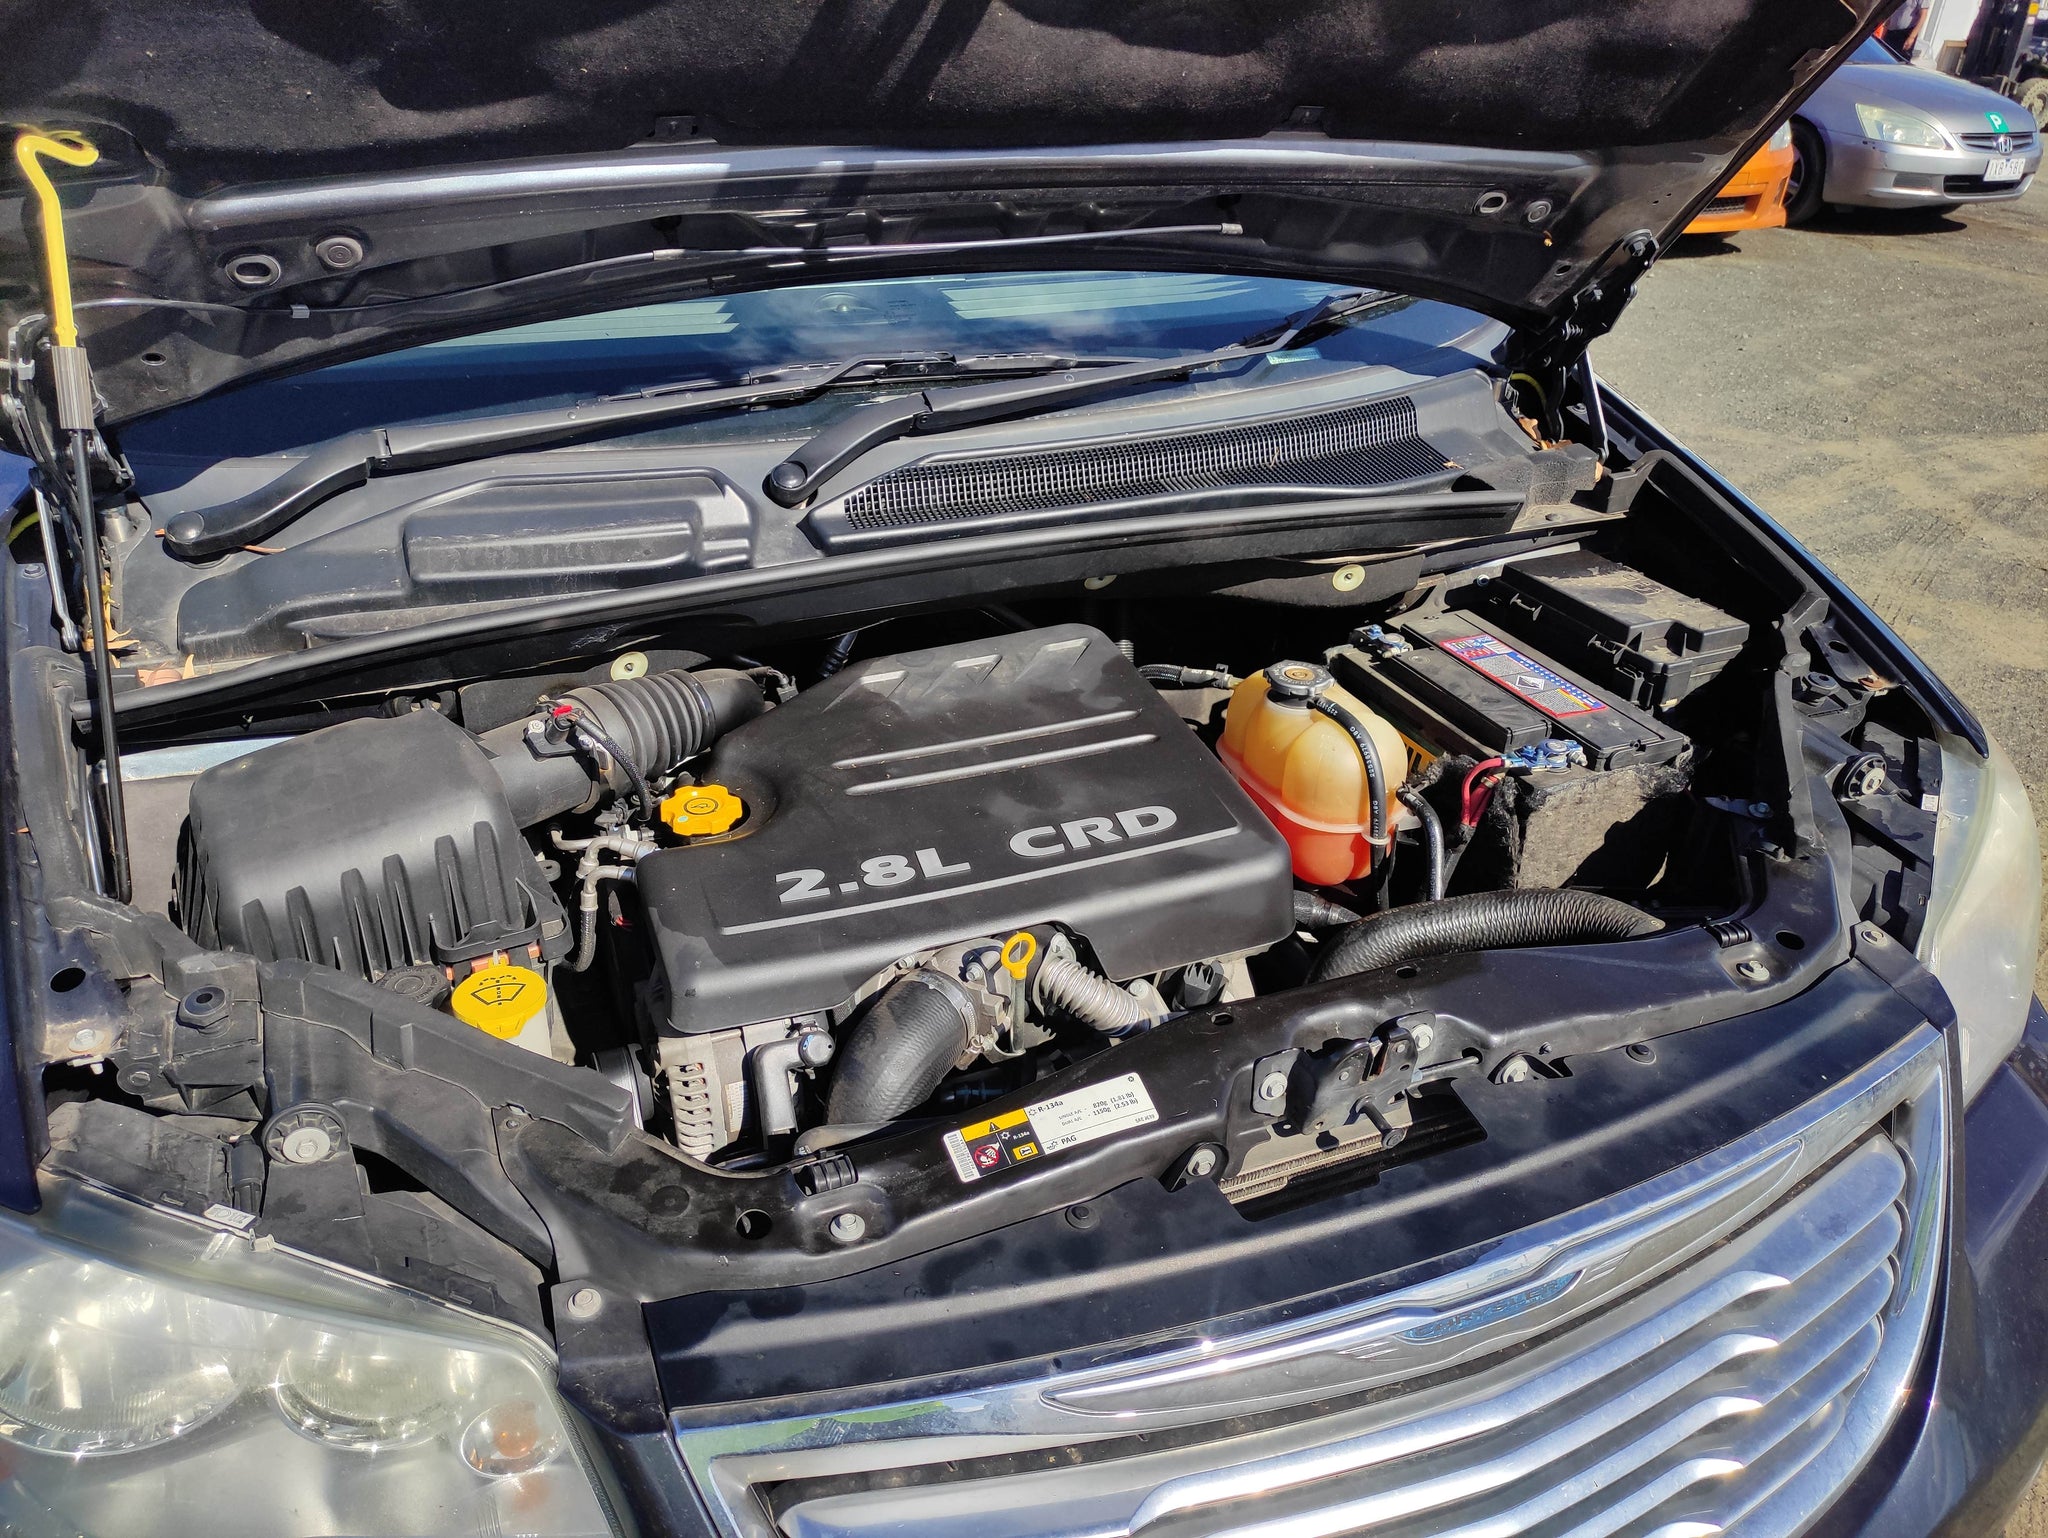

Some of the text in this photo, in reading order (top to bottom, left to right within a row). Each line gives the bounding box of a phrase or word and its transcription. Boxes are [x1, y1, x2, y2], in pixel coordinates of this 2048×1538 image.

[1990, 114, 2002, 130] P
[775, 805, 1178, 903] 2.8L CRD
[1037, 1100, 1064, 1113] R-134a
[1061, 1134, 1077, 1145] PAG
